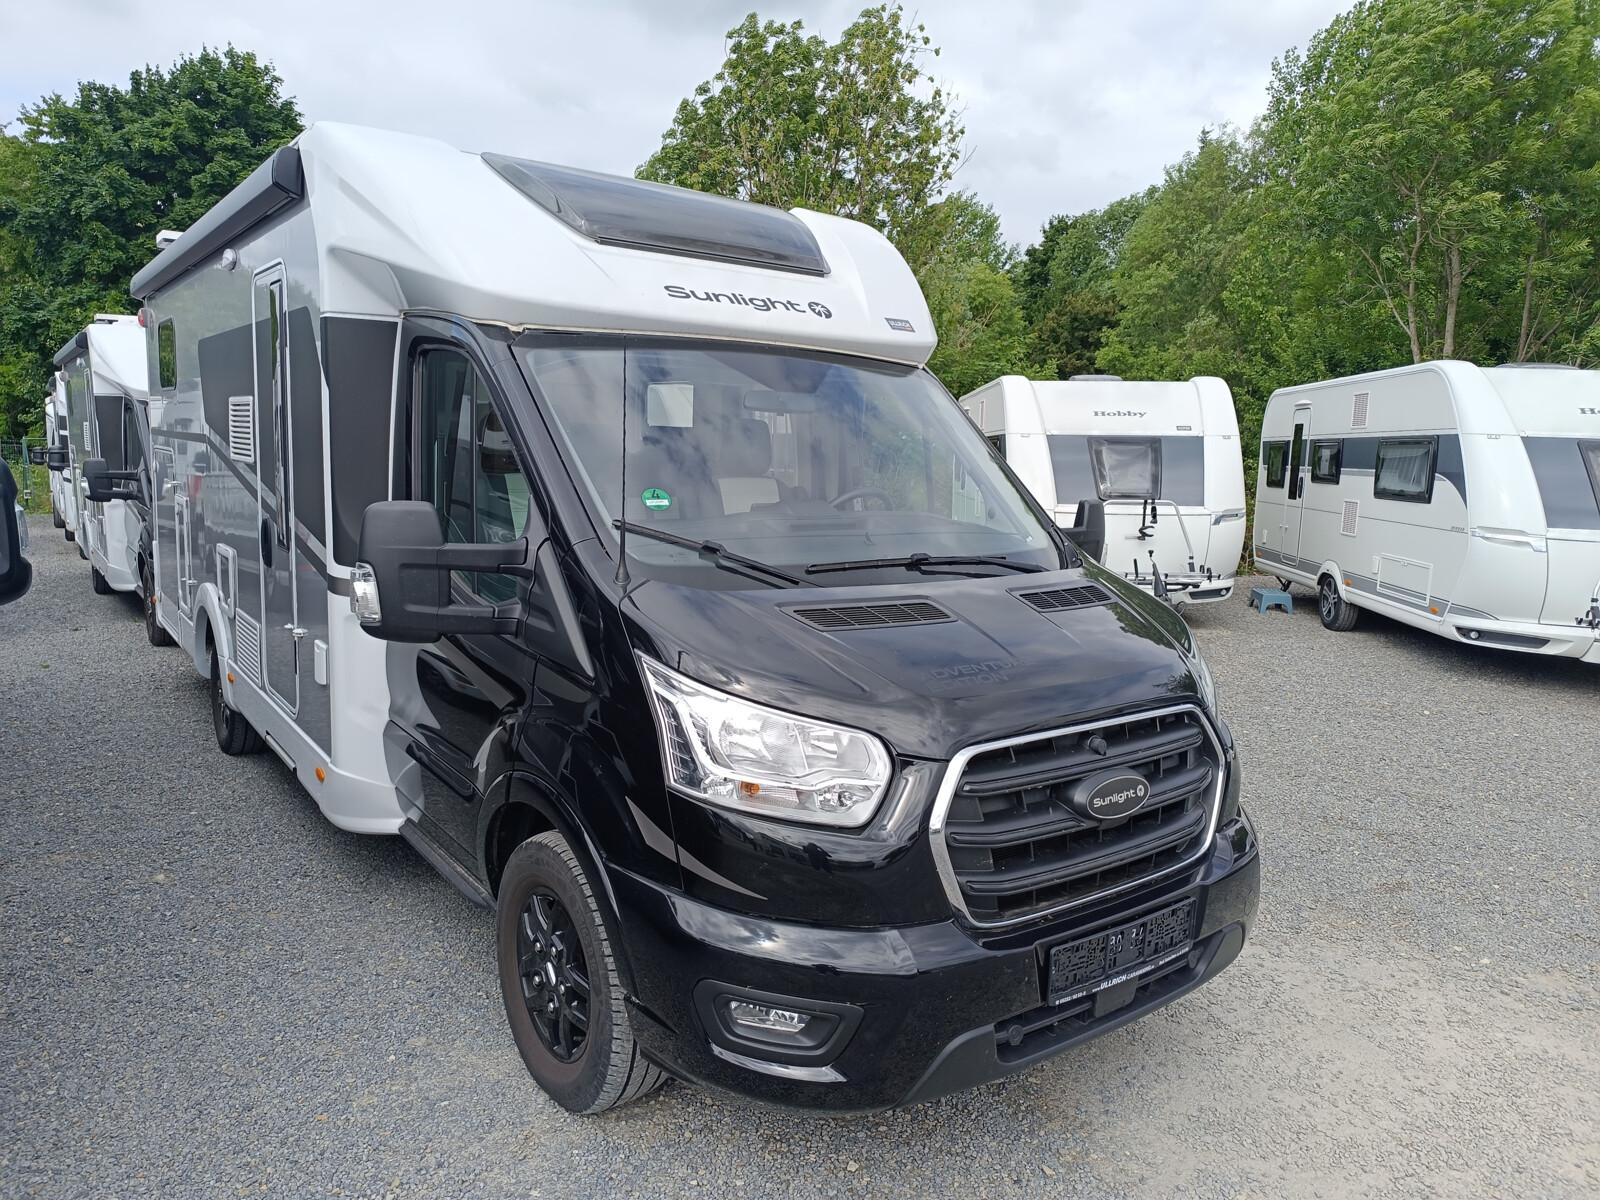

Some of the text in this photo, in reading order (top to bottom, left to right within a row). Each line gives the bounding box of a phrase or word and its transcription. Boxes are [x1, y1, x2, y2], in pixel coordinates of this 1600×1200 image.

[664, 285, 806, 312] Sunlight
[1093, 410, 1147, 418] Hobby
[651, 489, 660, 499] 4
[1093, 788, 1136, 808] Sunlight
